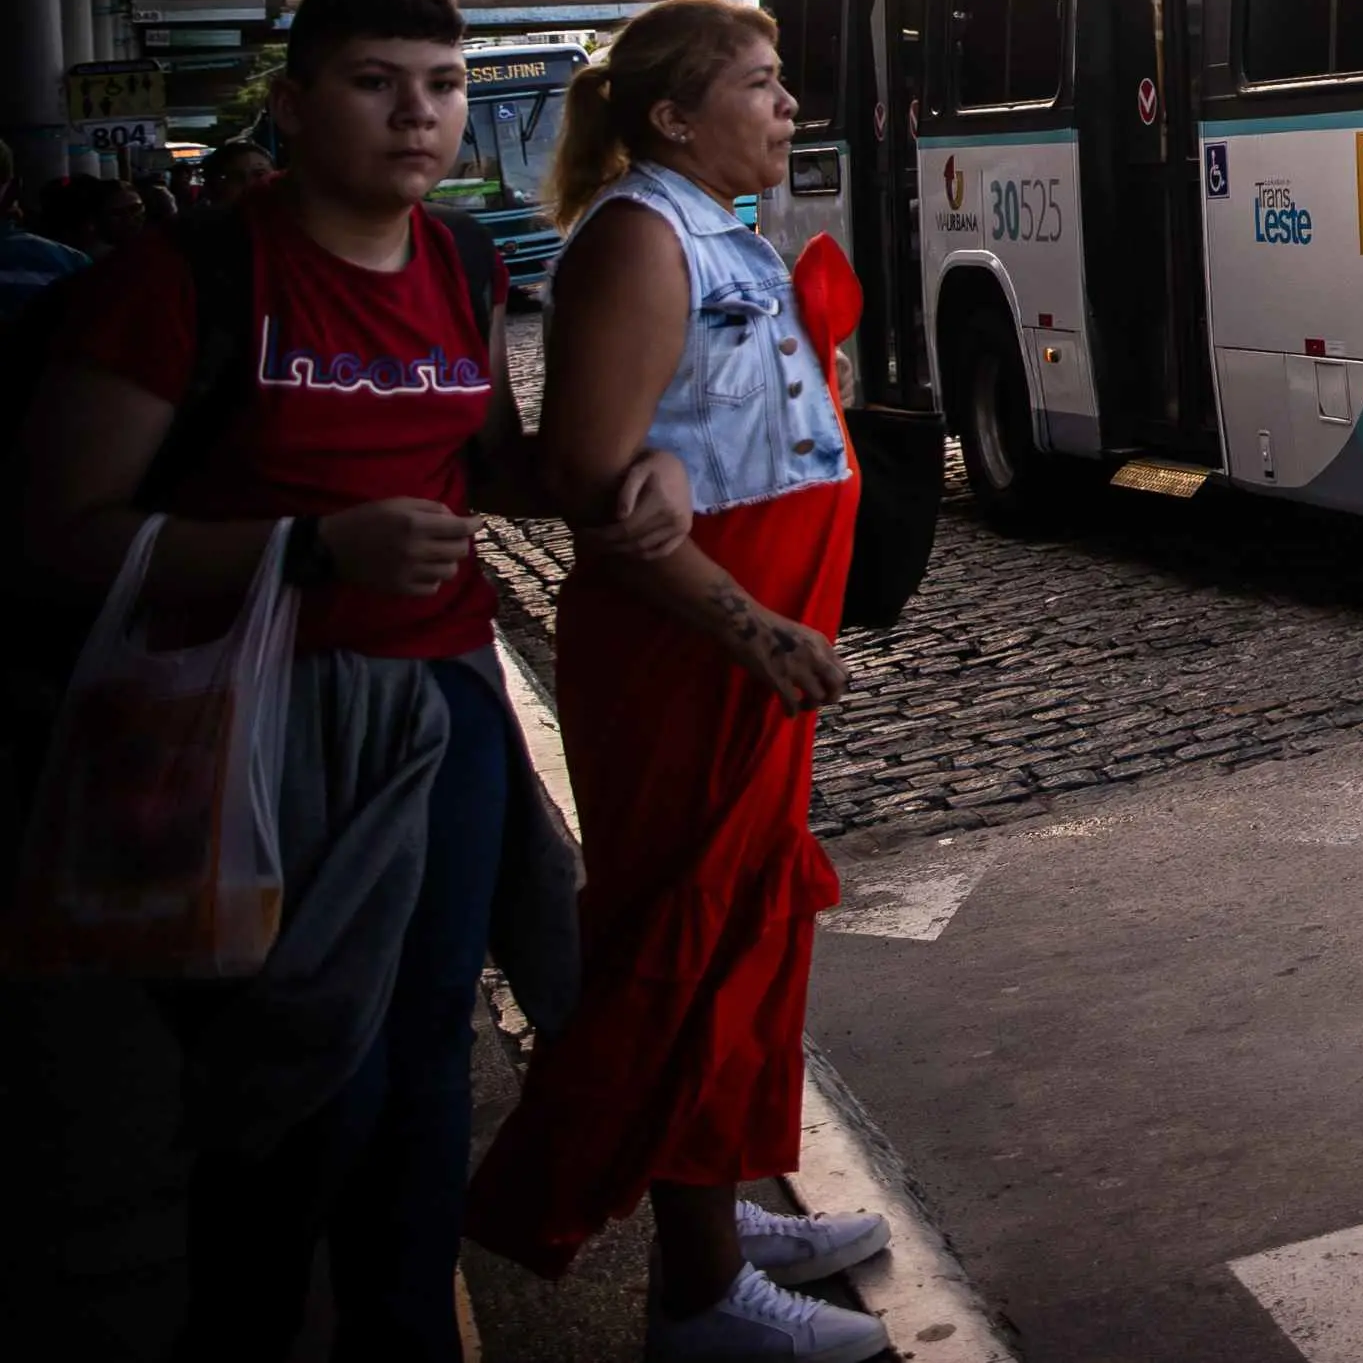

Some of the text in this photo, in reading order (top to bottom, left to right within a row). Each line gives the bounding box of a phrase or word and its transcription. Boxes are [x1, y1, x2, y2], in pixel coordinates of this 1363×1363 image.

[466, 62, 547, 84] ESSEJANA
[92, 124, 146, 149] 804
[1255, 182, 1291, 208] Trans
[990, 178, 1062, 242] 30525
[1255, 197, 1312, 245] Leste
